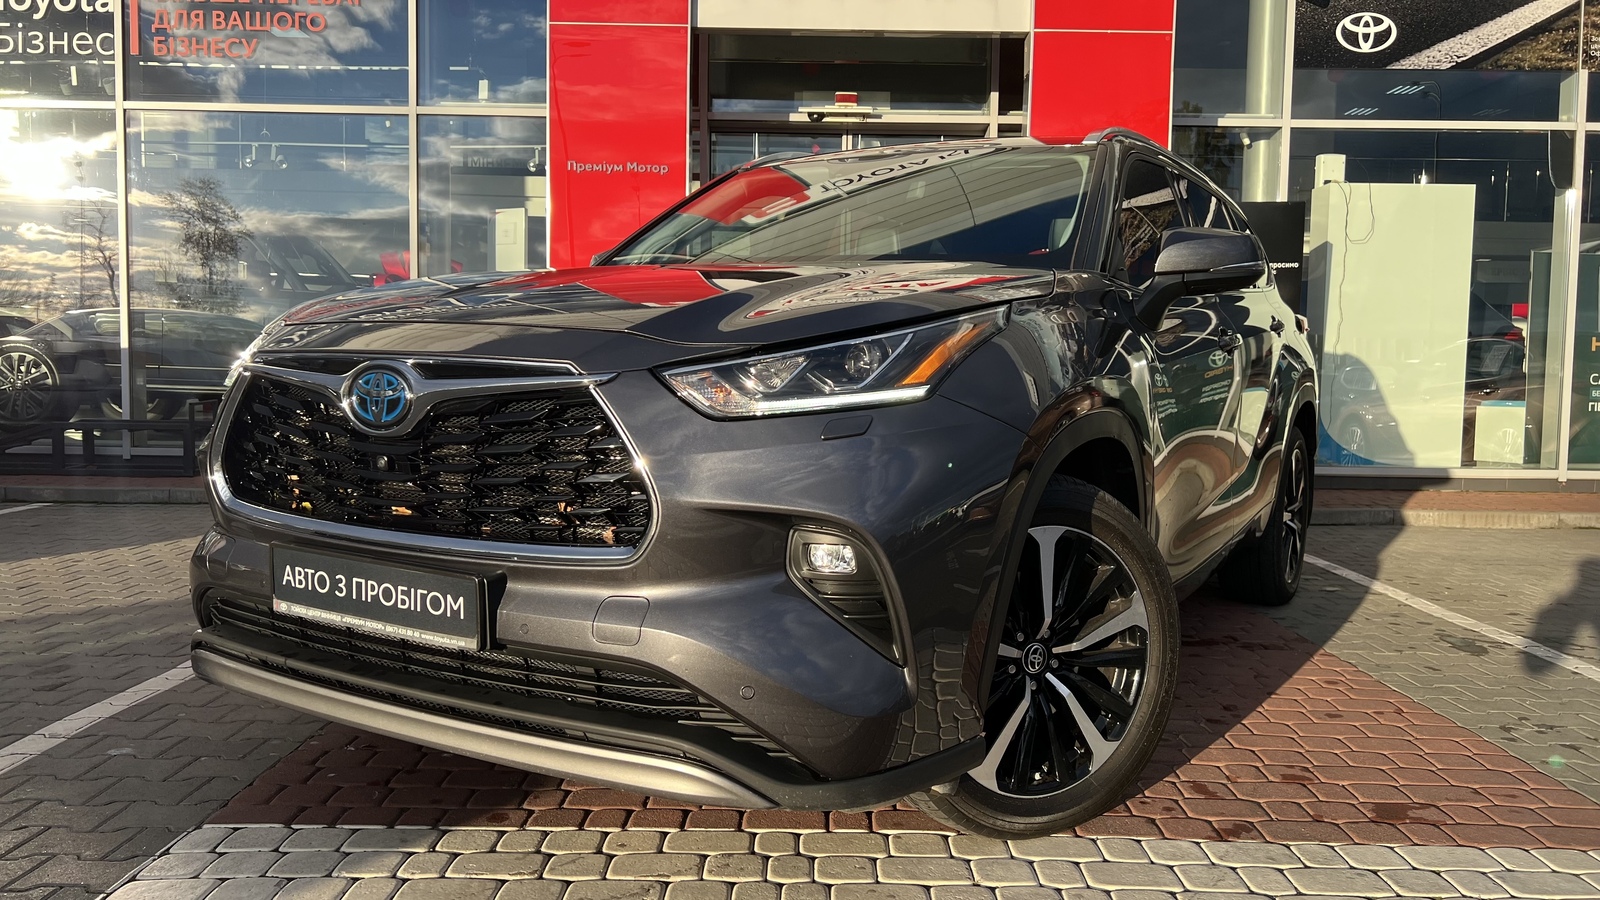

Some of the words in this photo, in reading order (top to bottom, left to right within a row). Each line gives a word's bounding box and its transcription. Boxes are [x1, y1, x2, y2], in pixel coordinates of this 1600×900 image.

[152, 9, 204, 32] ДЛЯ
[212, 11, 326, 32] ВАШОГО
[153, 36, 258, 58] БІЗНЕСУ
[567, 160, 623, 174] Преміум
[626, 161, 669, 175] Мотор
[282, 564, 330, 594] АВТО
[334, 574, 347, 597] З
[352, 577, 465, 620] ПРОБІГОМ
